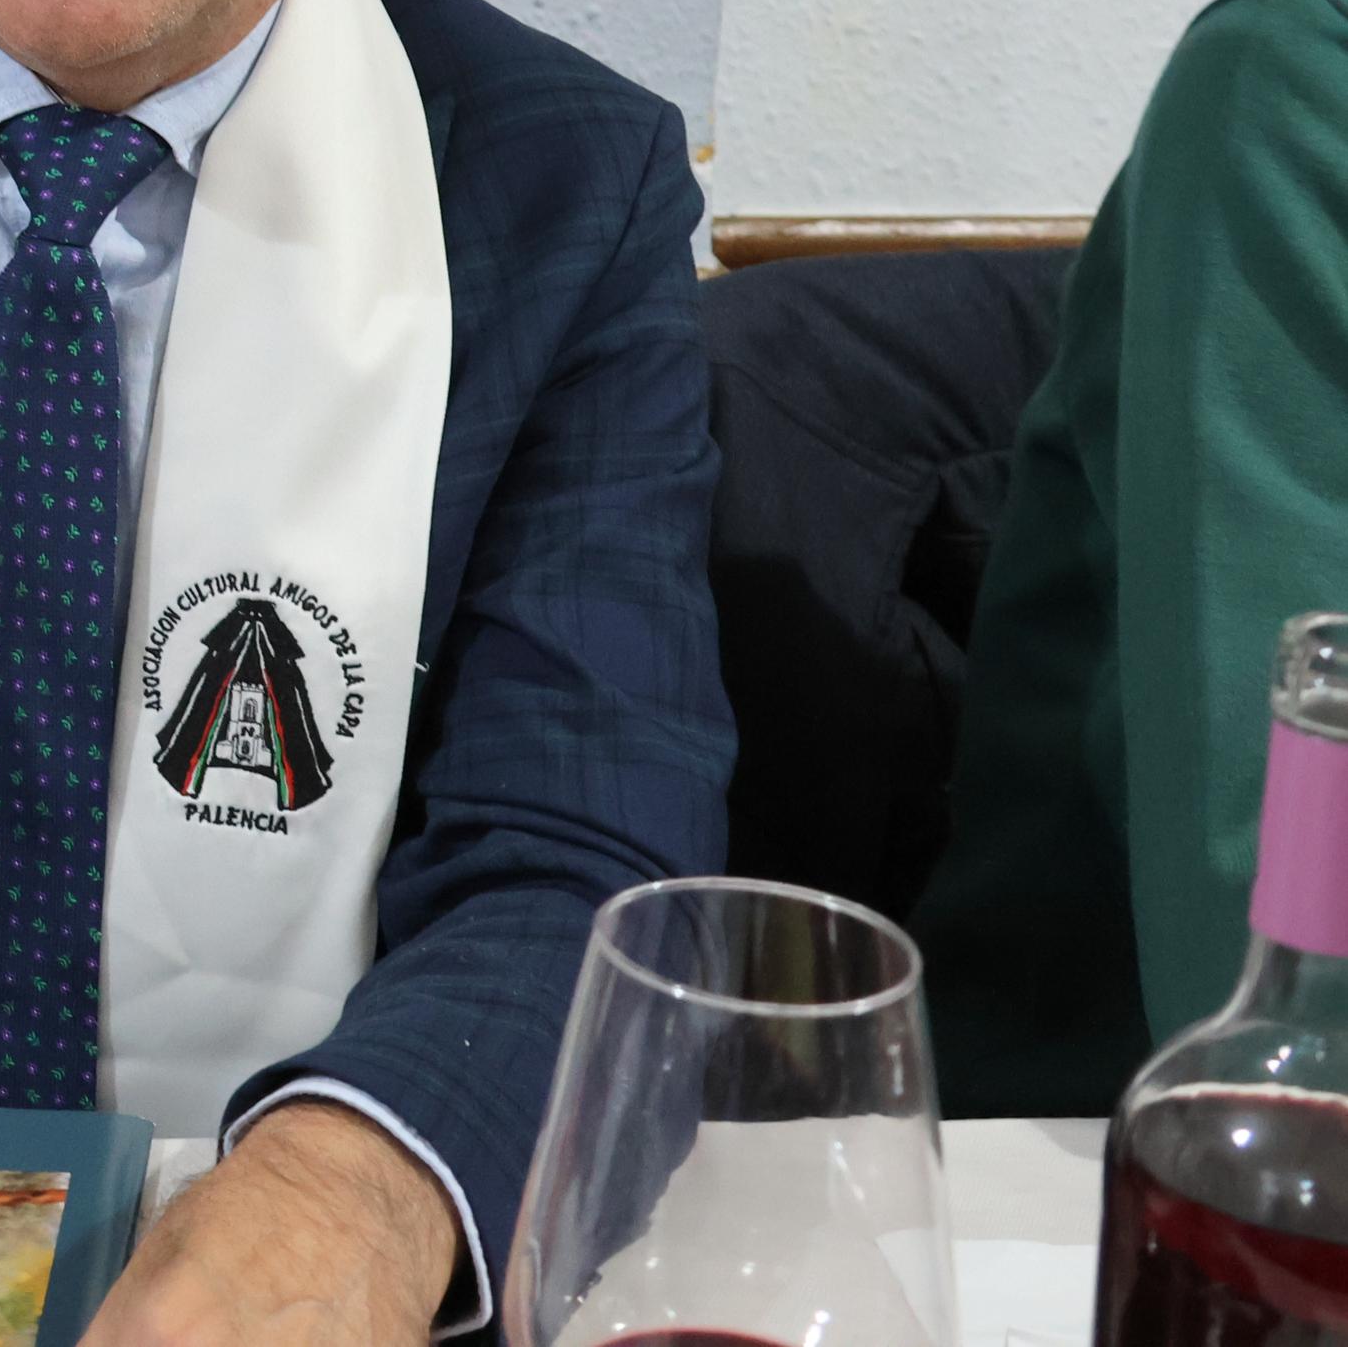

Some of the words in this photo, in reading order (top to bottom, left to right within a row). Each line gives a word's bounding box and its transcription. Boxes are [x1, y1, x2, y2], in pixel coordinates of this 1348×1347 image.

[176, 571, 262, 612] CULTURAL
[269, 576, 338, 630] AMIGOS
[142, 606, 182, 712] ASOCIACION
[328, 628, 359, 658] DE
[342, 662, 366, 687] LA
[335, 692, 365, 739] CAPA
[183, 803, 289, 836] PALENCIA
